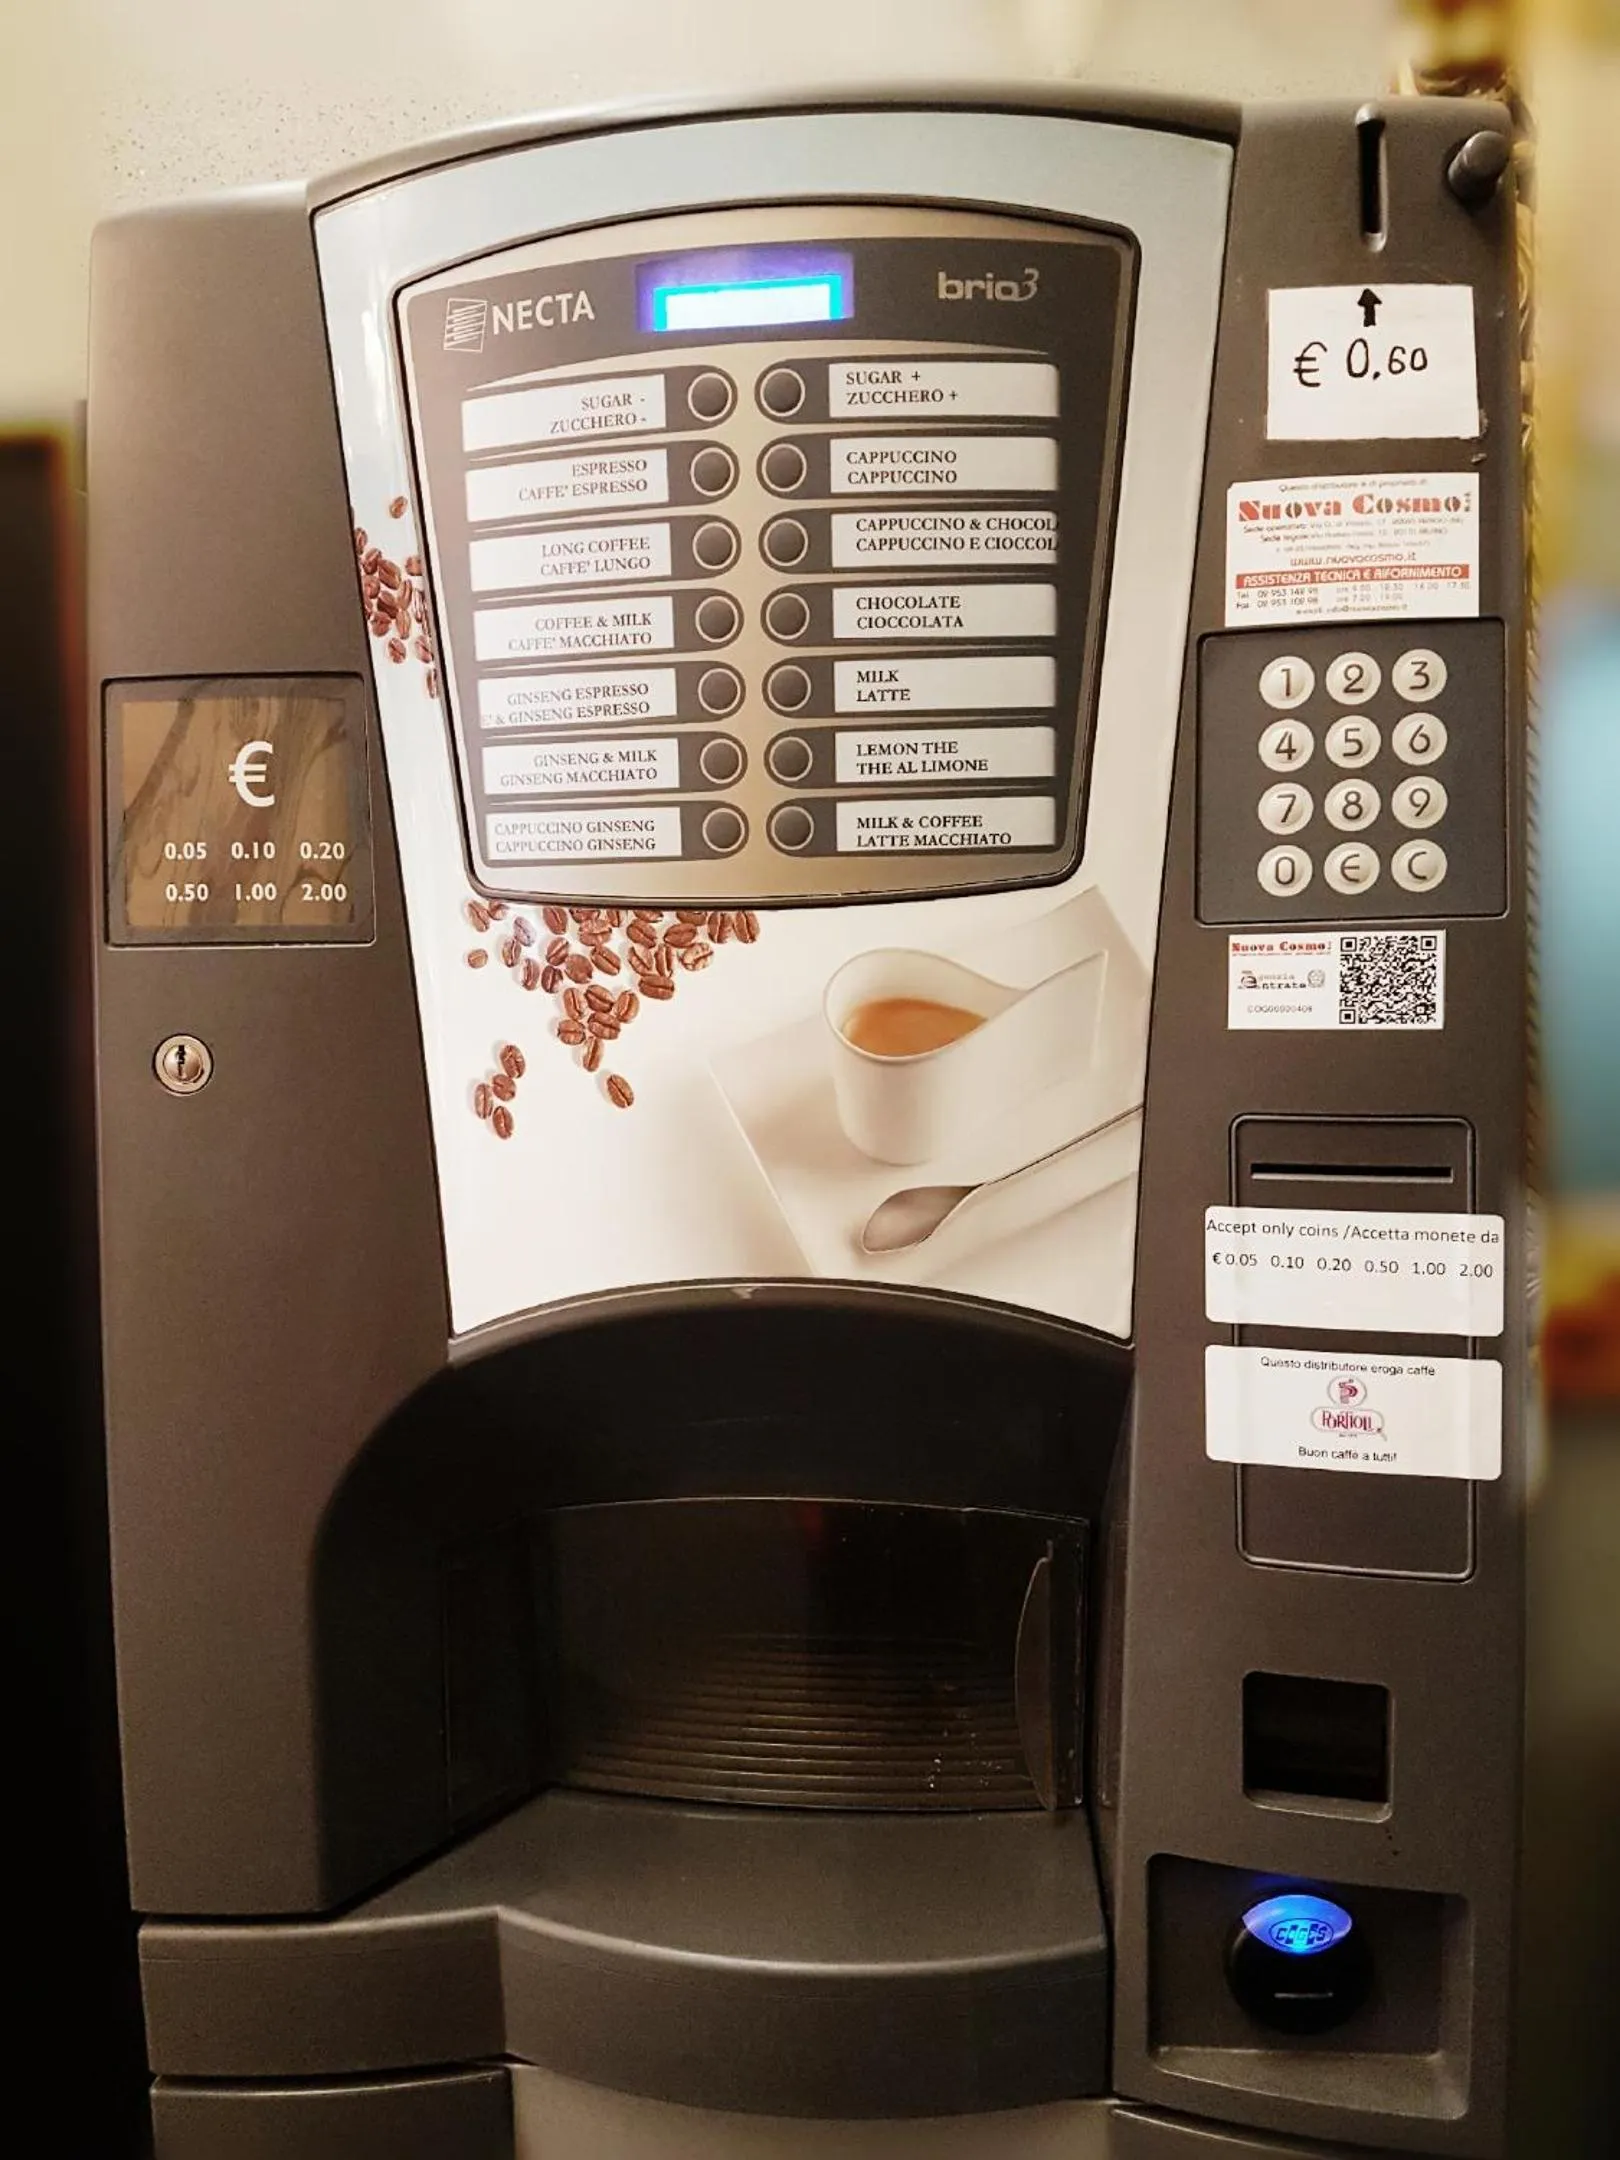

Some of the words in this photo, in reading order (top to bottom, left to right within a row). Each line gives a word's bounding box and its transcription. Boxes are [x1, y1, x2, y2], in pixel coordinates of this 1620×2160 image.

[492, 290, 595, 335] NECTA
[1293, 341, 1328, 388] €
[846, 370, 902, 385] SUGAR
[911, 371, 921, 382] +
[581, 392, 633, 409] SUGAR
[847, 388, 944, 405] ZUCCHERO
[949, 390, 959, 401] +
[549, 412, 637, 434] ZUCCHERO
[846, 450, 957, 465] CAPPUCCINO
[572, 458, 648, 477] ESPRESSO
[847, 469, 957, 484] CAPPUCCINO
[518, 484, 567, 502] CAFFE'
[572, 478, 648, 497] ESPRESSO
[1239, 500, 1342, 521] Nuova
[1352, 493, 1461, 515] Cosmo
[856, 518, 965, 532] CAPPUCCINO
[969, 518, 981, 530] &
[542, 542, 584, 558] LONG
[588, 537, 650, 553] COFFEE
[856, 537, 965, 552] CAPPUCCINO
[970, 537, 980, 550] E
[540, 560, 590, 577] CAFFE'
[595, 556, 650, 573] LUNGO
[1243, 573, 1311, 588] ASSISTENZA
[1313, 568, 1361, 583] TECNICA
[1363, 570, 1370, 580] E
[1374, 565, 1462, 579] RIFORNIMENTO
[856, 595, 961, 610] CHOCOLATE
[535, 616, 593, 631] COFFEE
[597, 615, 608, 628] &
[612, 612, 652, 627] MILK
[857, 615, 964, 630] CIOCCOLATA
[508, 636, 555, 651] CAFFE'
[560, 631, 652, 649] MACCHIATO
[856, 670, 899, 683] MILK
[1281, 668, 1291, 697] 1
[1343, 664, 1364, 693] 2
[1410, 661, 1430, 690] 3
[506, 688, 572, 706] GINSENG
[575, 683, 649, 700] ESPRESSO
[856, 689, 911, 702] LATTE
[508, 707, 573, 724] GINSENG
[577, 701, 650, 718] ESPRESSO
[856, 742, 918, 757] LEMON
[922, 741, 958, 754] THE
[1275, 731, 1297, 760] 4
[1343, 728, 1363, 757] 5
[1409, 724, 1431, 753] 6
[534, 752, 599, 768] GINSENG
[602, 753, 613, 764] &
[618, 750, 657, 763] MILK
[856, 762, 892, 775] THE
[896, 761, 918, 774] AL
[922, 759, 989, 773] LIMONE
[228, 740, 275, 808] €
[500, 771, 563, 787] GINSENG
[566, 767, 658, 784] MACCHIATO
[1277, 793, 1297, 823] 7
[1342, 791, 1363, 820] 8
[1409, 788, 1431, 817] 9
[494, 821, 582, 836] CAPPUCCINO
[586, 819, 655, 834] GINSENG
[856, 816, 898, 829] MILK
[902, 817, 914, 829] &
[919, 815, 983, 828] COFFEE
[495, 839, 583, 853] CAPPUCCINO
[587, 837, 656, 851] GINSENG
[856, 834, 910, 848] LATTE
[914, 832, 1012, 846] MACCHIATO
[164, 842, 207, 860] 0.05
[231, 842, 276, 860] 0.10
[300, 842, 345, 860] 0.20
[1275, 856, 1295, 885] 0
[1408, 851, 1428, 881] C
[165, 884, 209, 902] 0.50
[235, 883, 277, 901] 1.00
[302, 883, 348, 902] 2.00
[1232, 942, 1274, 952] Nuova
[1280, 941, 1326, 951] Cosmo
[1207, 1219, 1256, 1235] Accept
[1262, 1222, 1293, 1237] only
[1299, 1224, 1338, 1237] coins
[1414, 1230, 1475, 1243] monete
[1481, 1230, 1499, 1243] da
[1270, 1255, 1304, 1269] 0.10
[1317, 1258, 1351, 1272] 0.20
[1364, 1260, 1399, 1274] 0.50
[1412, 1261, 1446, 1275] 1.00
[1459, 1263, 1493, 1278] 2.00
[1260, 1356, 1301, 1369] Questo
[1303, 1359, 1368, 1373] distributore
[1371, 1365, 1404, 1376] eroga
[1298, 1446, 1328, 1458] Buon
[1362, 1453, 1370, 1461] a
